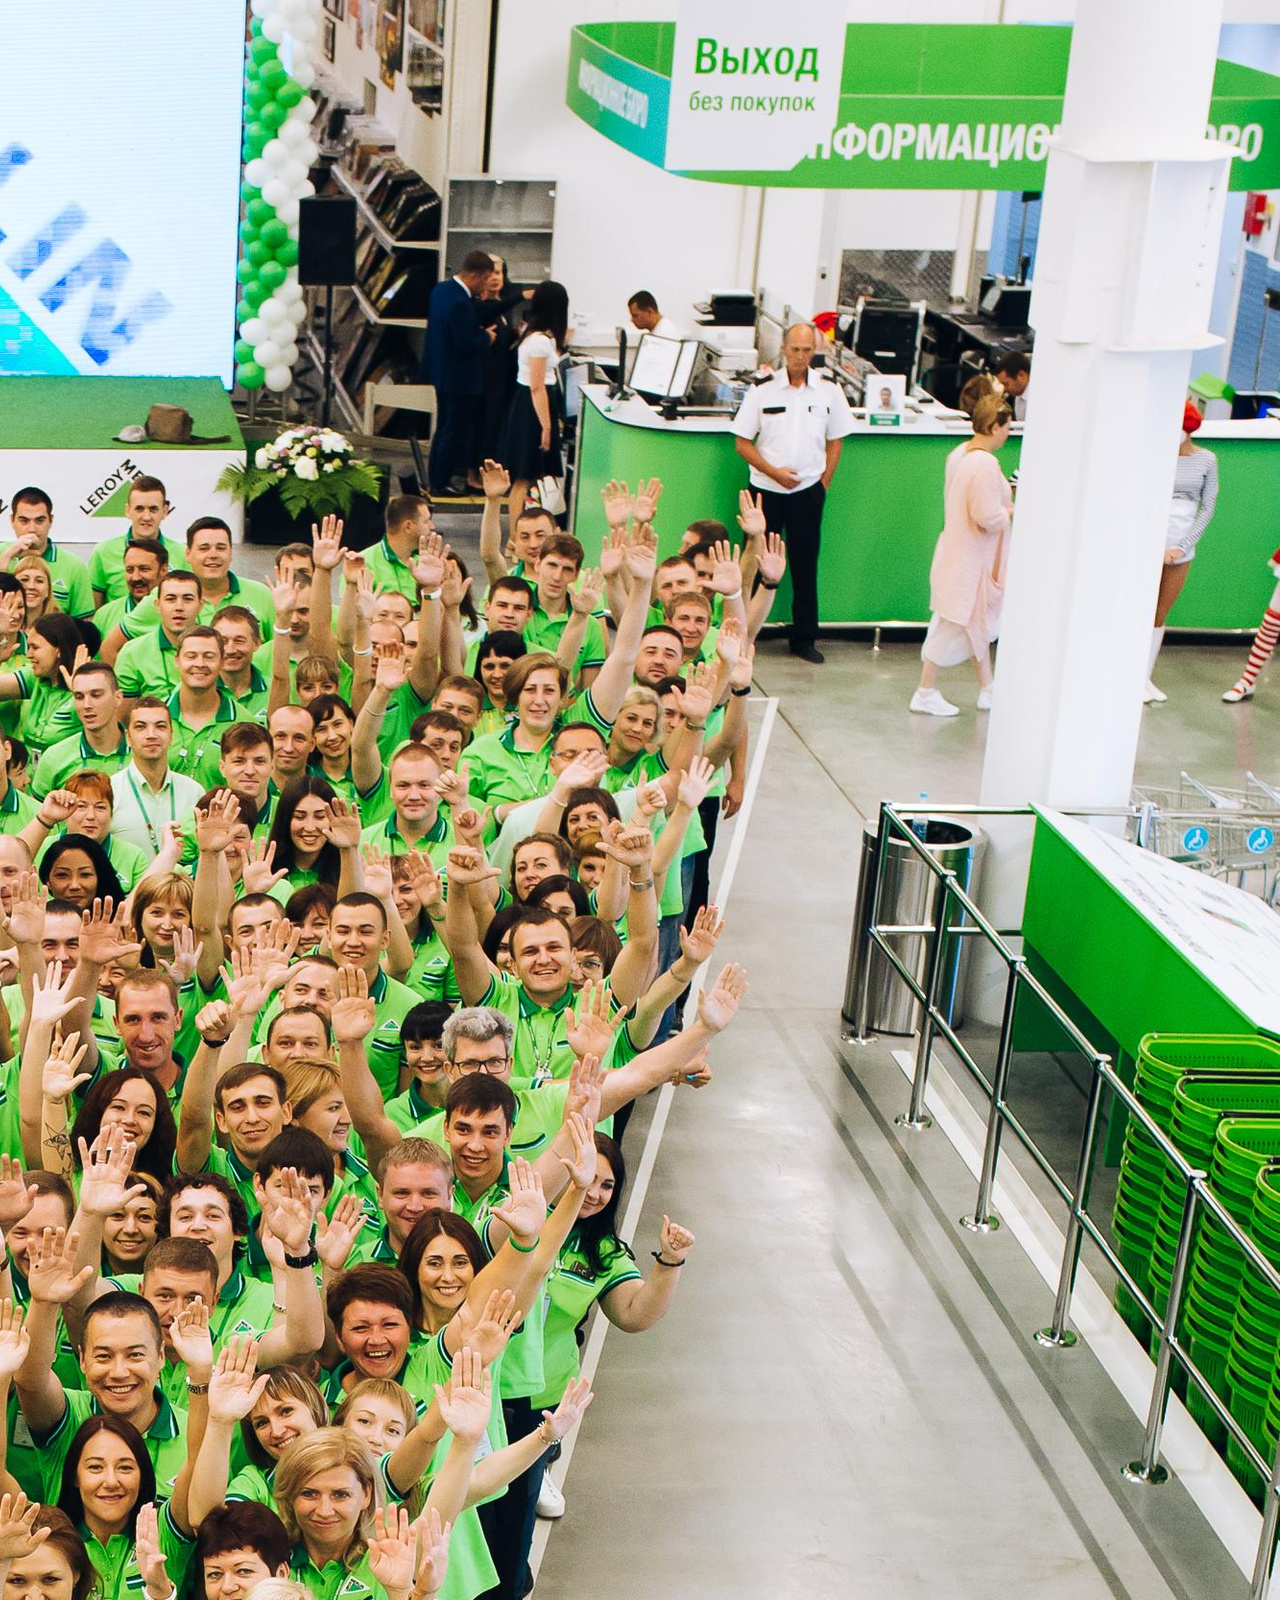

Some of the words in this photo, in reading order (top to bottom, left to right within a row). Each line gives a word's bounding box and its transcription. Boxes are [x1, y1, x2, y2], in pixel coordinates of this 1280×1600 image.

[694, 37, 819, 82] Выход
[689, 90, 723, 111] без
[730, 94, 816, 115] покупок
[79, 469, 123, 515] LEROY
